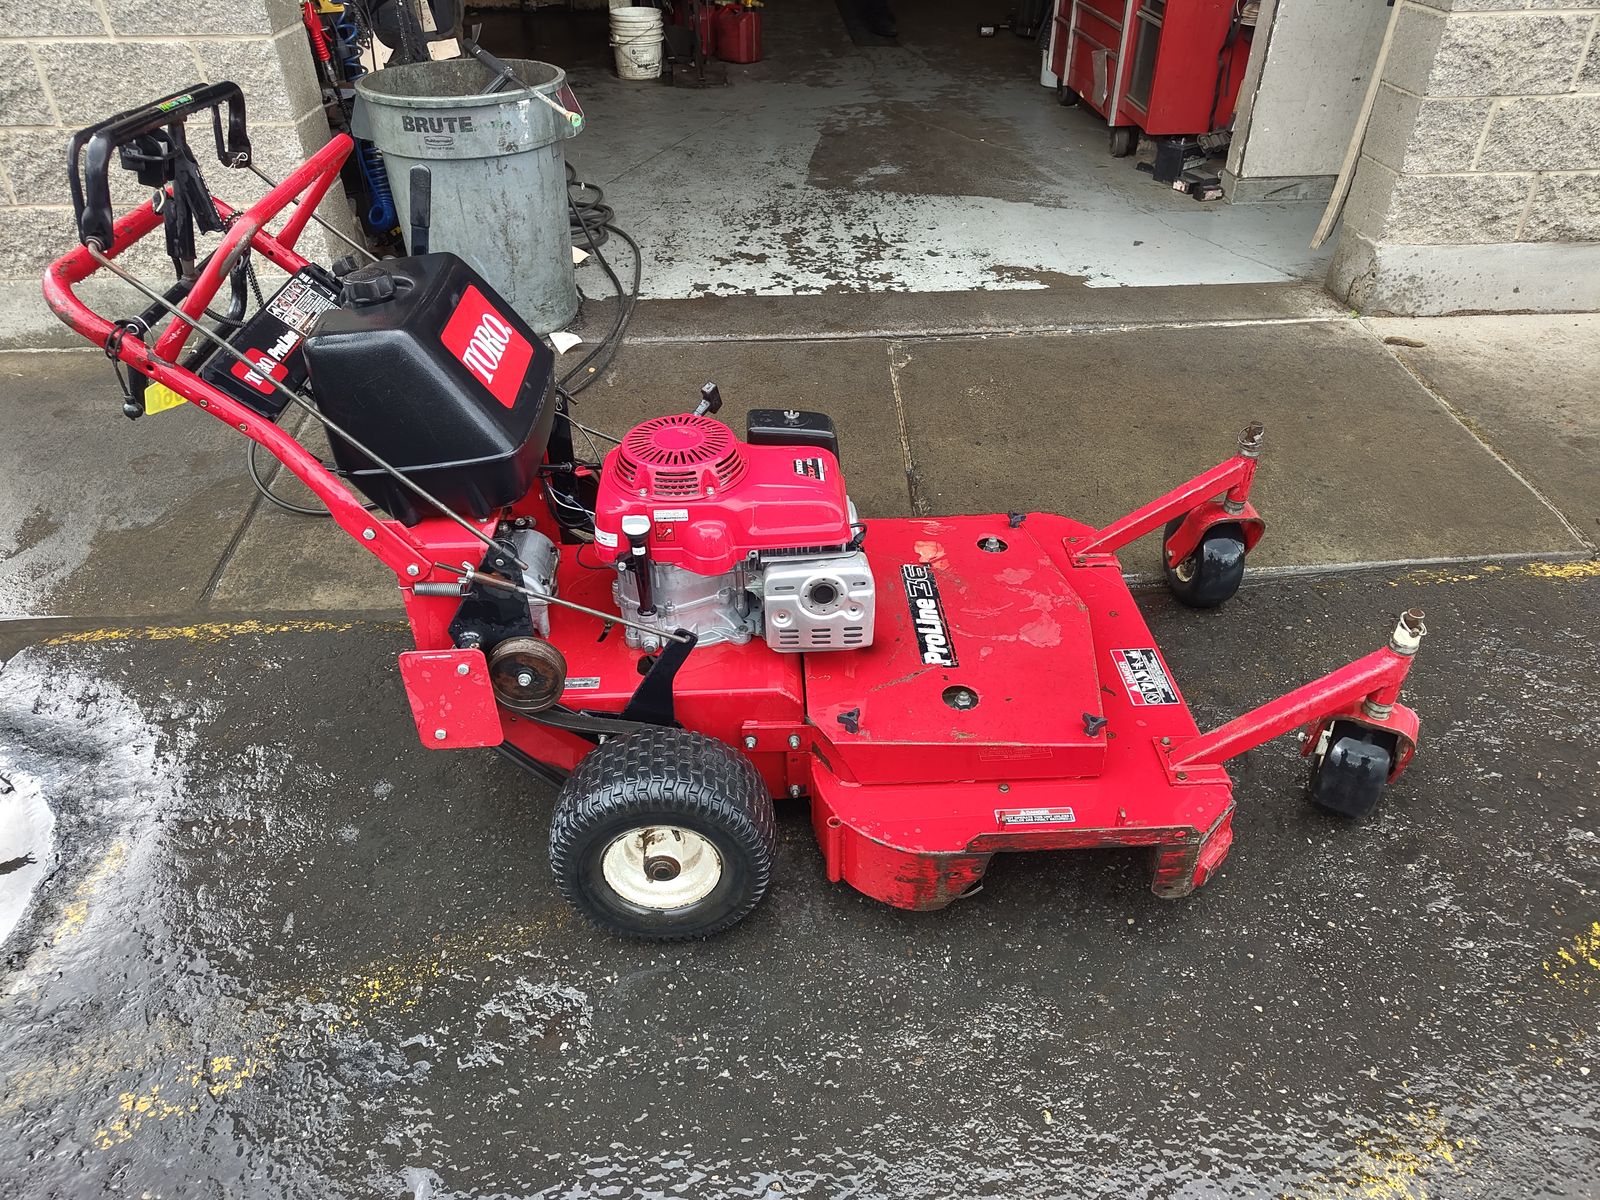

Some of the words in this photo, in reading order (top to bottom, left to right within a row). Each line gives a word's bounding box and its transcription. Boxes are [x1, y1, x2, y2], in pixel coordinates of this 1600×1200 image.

[402, 115, 473, 133] BRUTE
[267, 330, 300, 362] ProLine
[462, 313, 510, 384] TORO
[916, 598, 952, 667] ProLine
